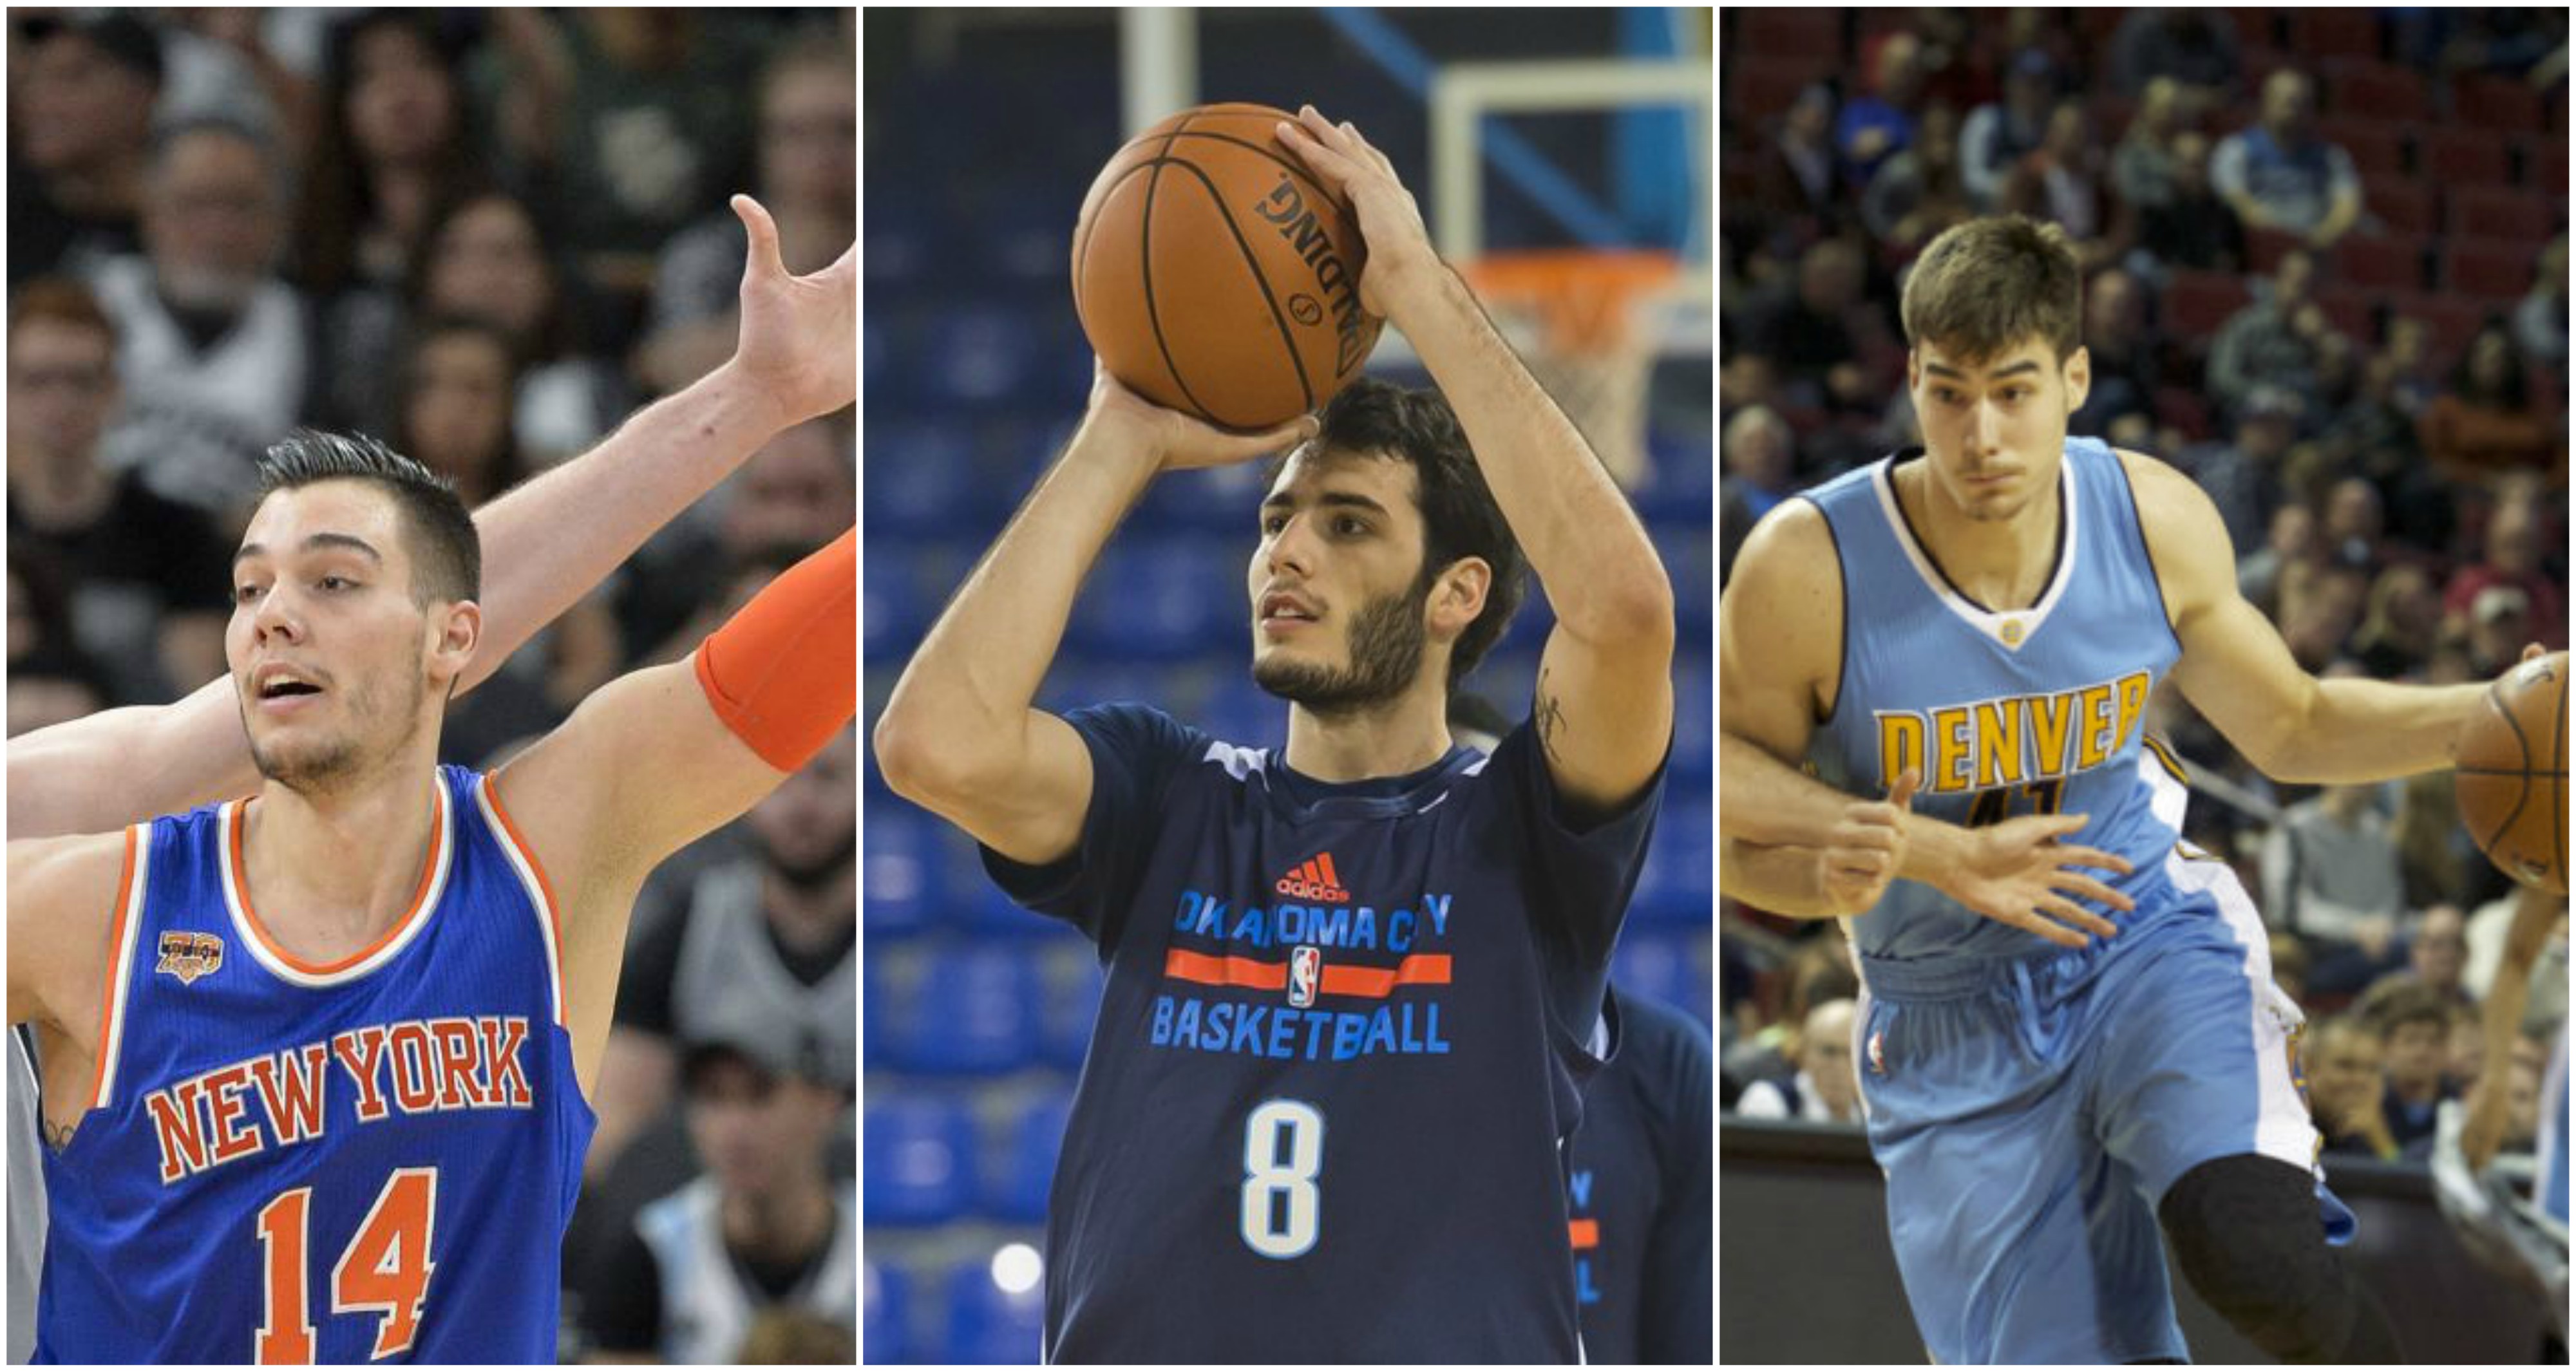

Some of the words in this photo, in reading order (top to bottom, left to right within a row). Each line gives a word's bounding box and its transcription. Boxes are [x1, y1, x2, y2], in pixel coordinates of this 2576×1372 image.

[1873, 668, 2152, 795] DENVER
[1174, 890, 1377, 951] OKAOMA
[1387, 892, 1453, 953] CY
[1276, 878, 1350, 902] adidas
[1151, 995, 1450, 1061] BASKETBALL
[144, 1044, 327, 1185] NEW
[333, 1017, 533, 1124] YORK
[1240, 1098, 1325, 1260] 8
[254, 1167, 438, 1365] 14
